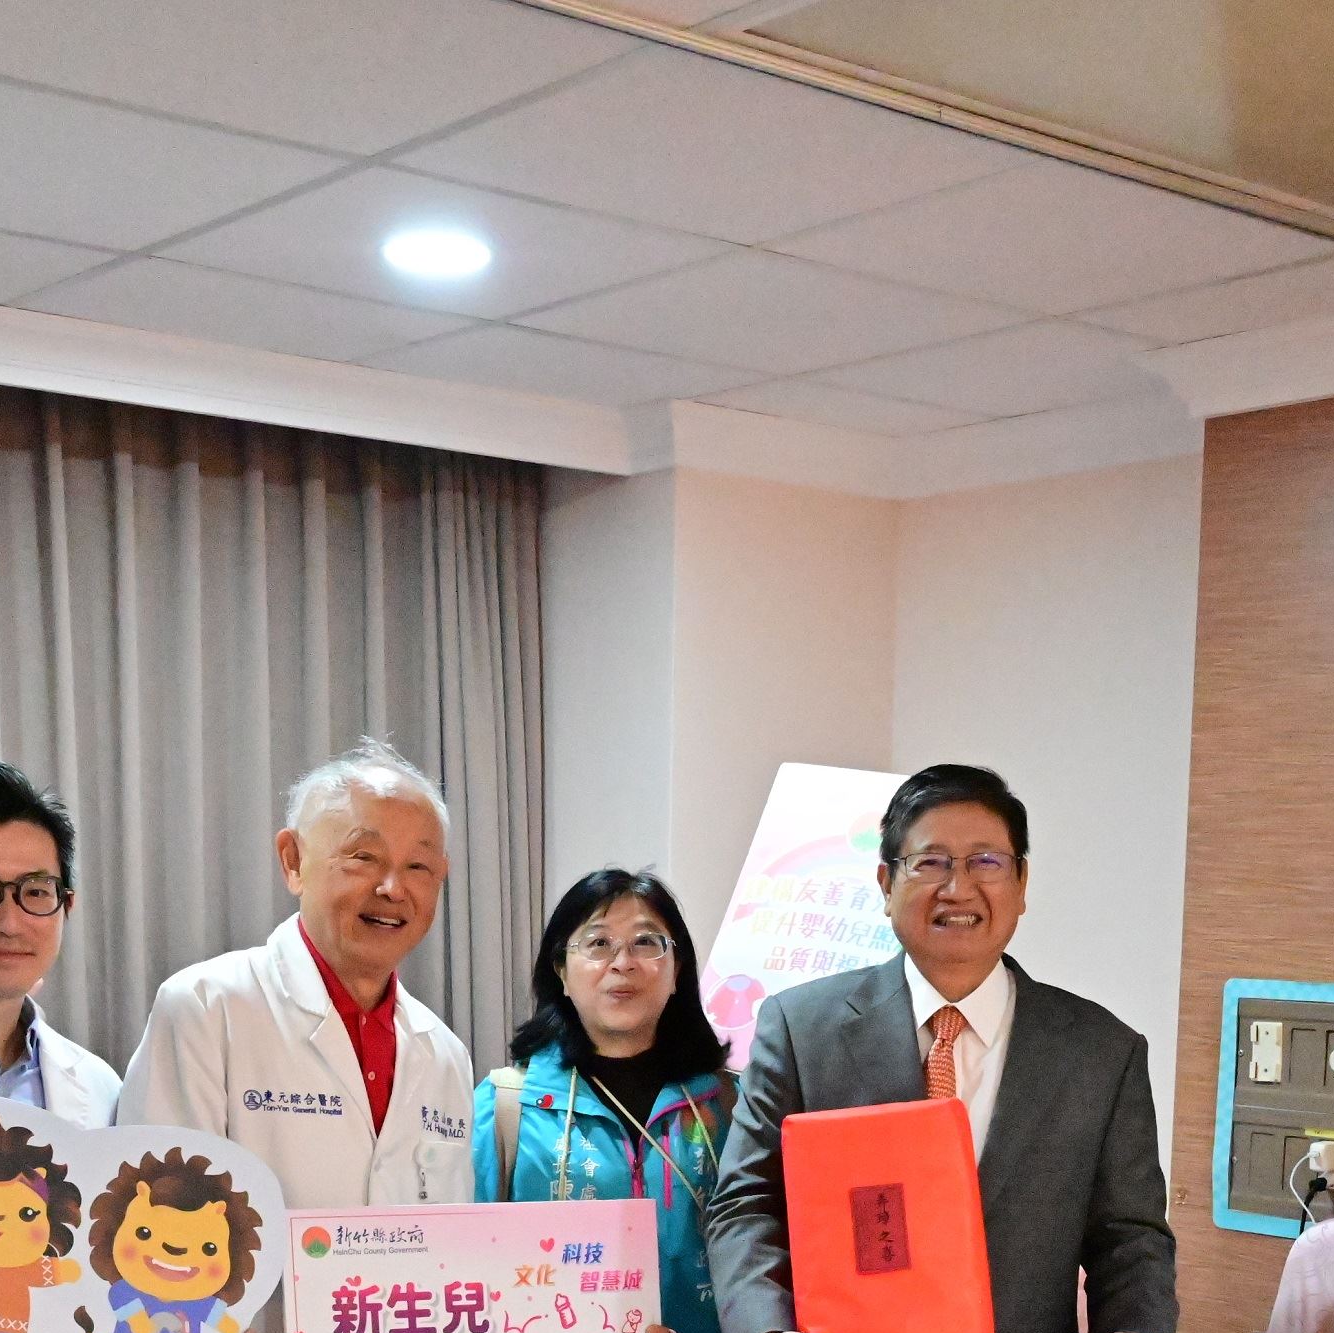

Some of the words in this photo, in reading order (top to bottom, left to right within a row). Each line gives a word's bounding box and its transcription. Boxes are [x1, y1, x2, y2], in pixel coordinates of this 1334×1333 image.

[762, 945, 883, 977] 品質與福
[262, 1090, 343, 1107] 東元綜合醫院
[292, 1106, 316, 1114] General
[319, 1108, 343, 1116] Hospital
[335, 1225, 424, 1247] 新竹縣政府
[364, 1247, 387, 1255] County
[389, 1246, 429, 1254] Government
[562, 1242, 604, 1265] 科技
[513, 1263, 556, 1288] 文化
[580, 1268, 643, 1293] 智慧城
